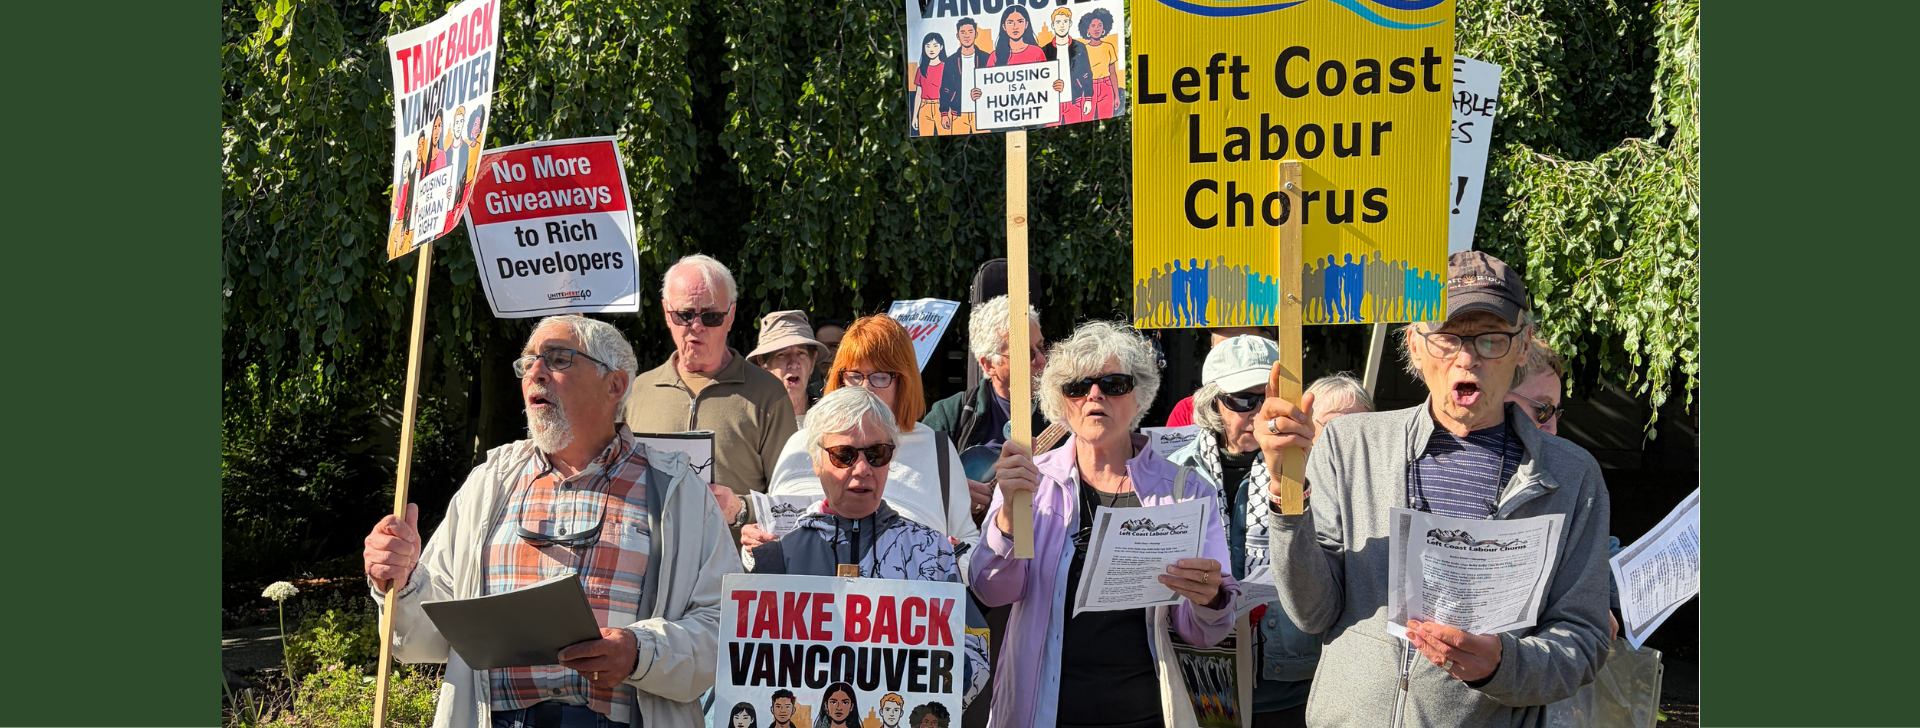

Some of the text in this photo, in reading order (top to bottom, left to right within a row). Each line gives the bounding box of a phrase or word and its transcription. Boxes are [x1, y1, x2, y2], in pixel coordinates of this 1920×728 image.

[396, 0, 496, 95] TAKE BACK
[983, 67, 1050, 85] HOUSING
[1008, 83, 1026, 92] IS A
[1138, 46, 1442, 105] Left Coast
[401, 51, 491, 138] VANCOUVER
[986, 90, 1048, 108] HUMAN
[994, 106, 1042, 123] RIGHT
[1189, 112, 1393, 164] Labour
[491, 154, 591, 184] No More
[420, 173, 447, 198] HOUSING
[417, 198, 444, 223] HUMAN
[485, 185, 612, 215] Giveaways
[1184, 178, 1389, 230] Chorus
[418, 216, 439, 237] RIGHT
[514, 219, 598, 247] to Rich
[496, 250, 624, 279] Developers
[580, 289, 592, 300] 40
[1426, 539, 1527, 552] Left Coast Labour Chorus
[731, 590, 956, 647] TAKE BACK
[728, 642, 954, 694] VANCOUVER
